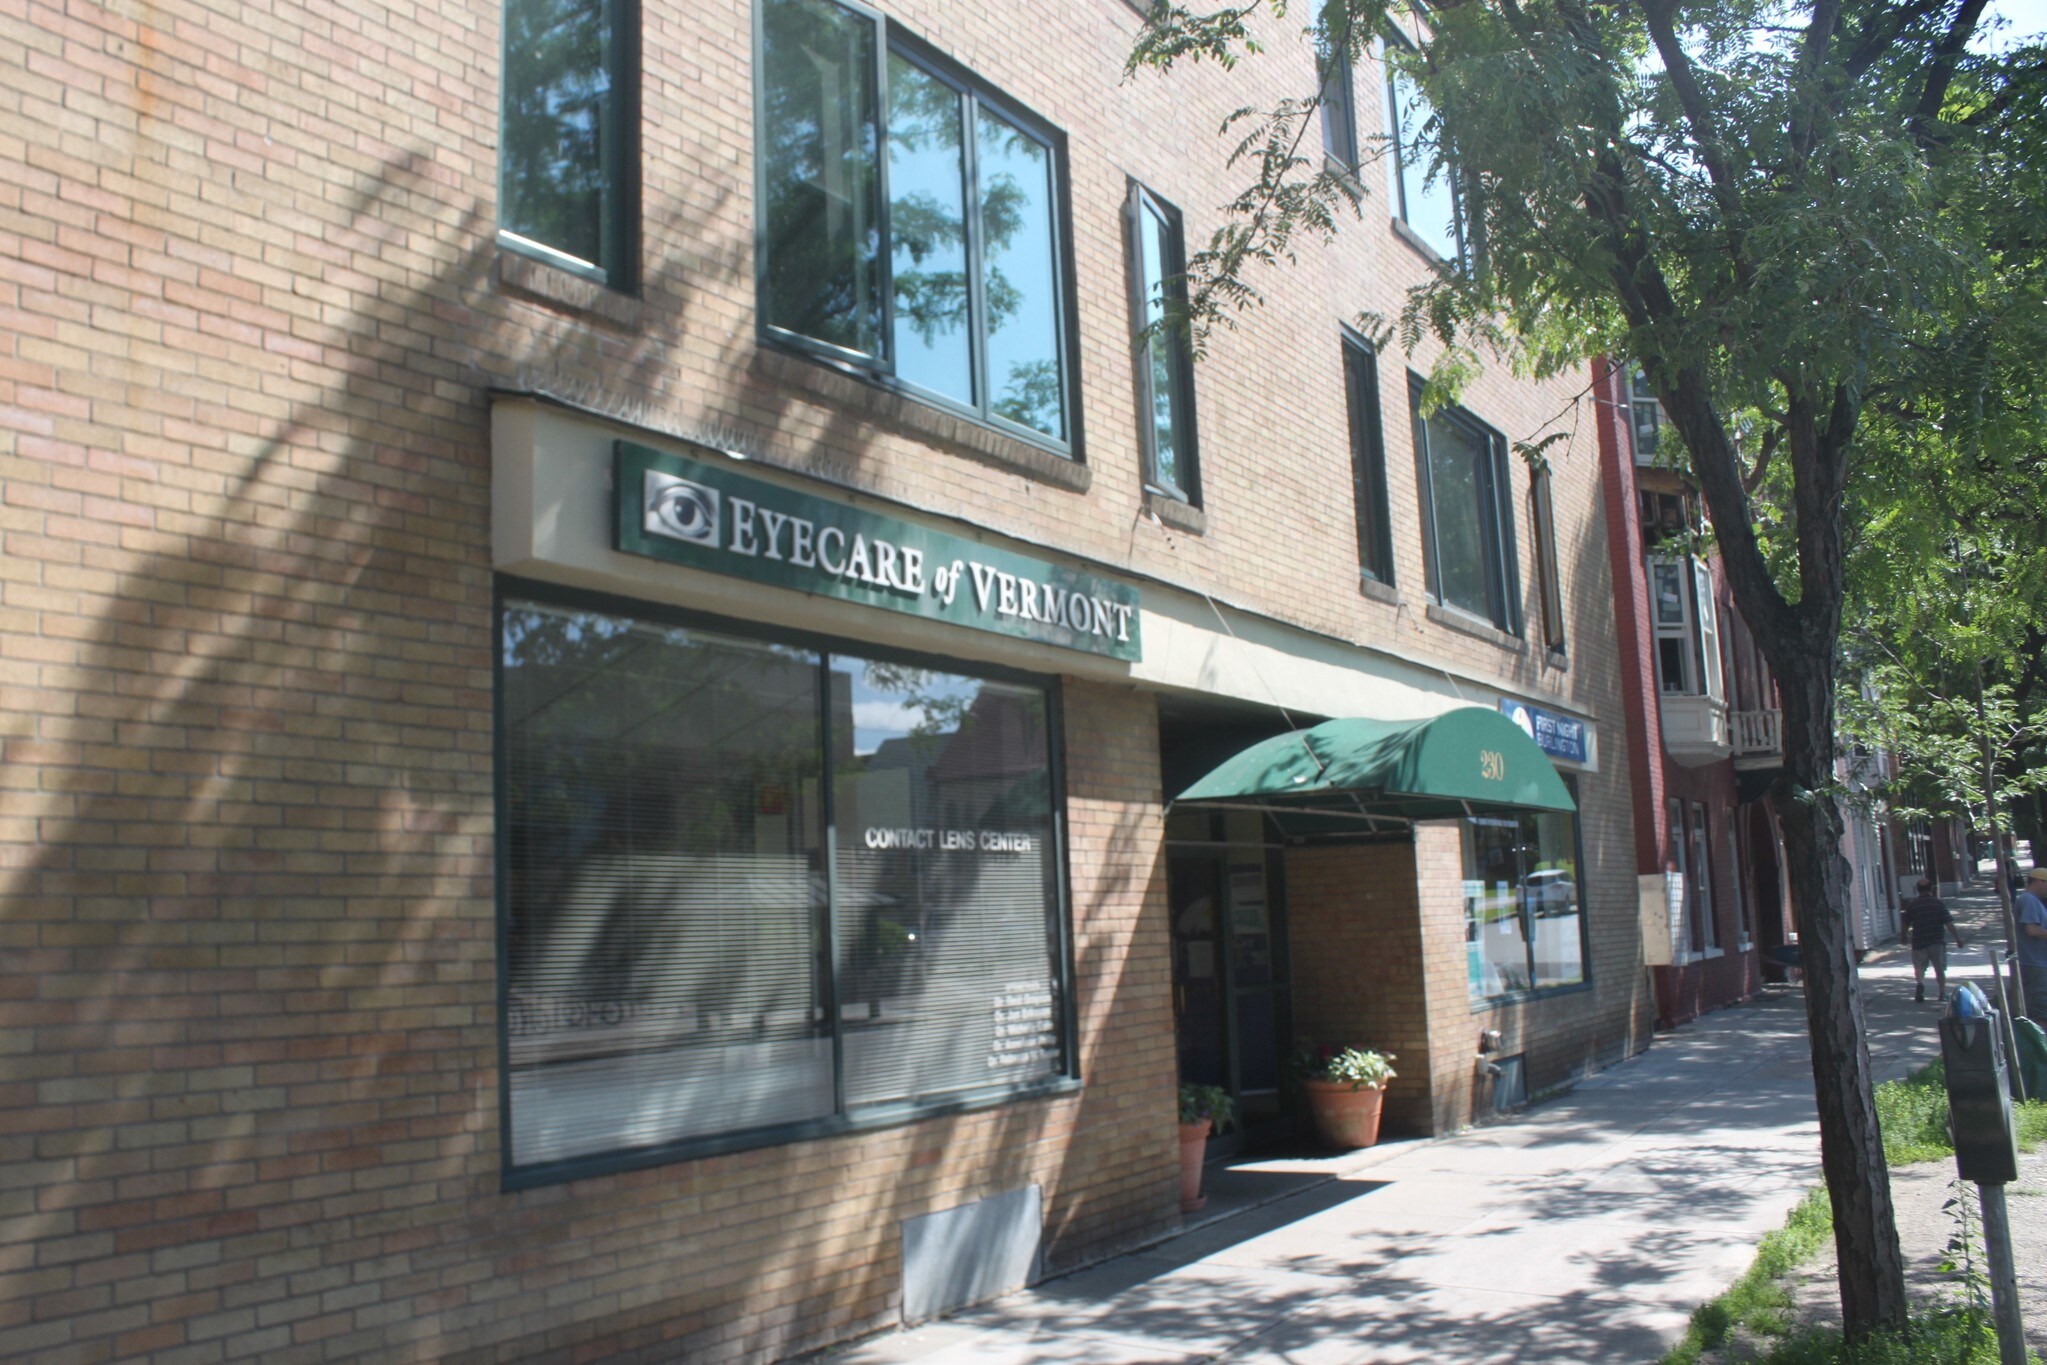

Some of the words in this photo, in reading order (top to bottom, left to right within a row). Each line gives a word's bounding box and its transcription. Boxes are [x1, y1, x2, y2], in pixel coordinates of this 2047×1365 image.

[727, 496, 926, 594] EYECARE
[934, 560, 965, 605] of
[967, 562, 1132, 642] VERMONT
[1535, 715, 1556, 734] FIRST
[1556, 721, 1578, 740] NIGHT
[1480, 750, 1504, 781] 230
[865, 827, 935, 849] CONTACT
[939, 830, 976, 850] LENS
[979, 831, 1032, 851] CENTER
